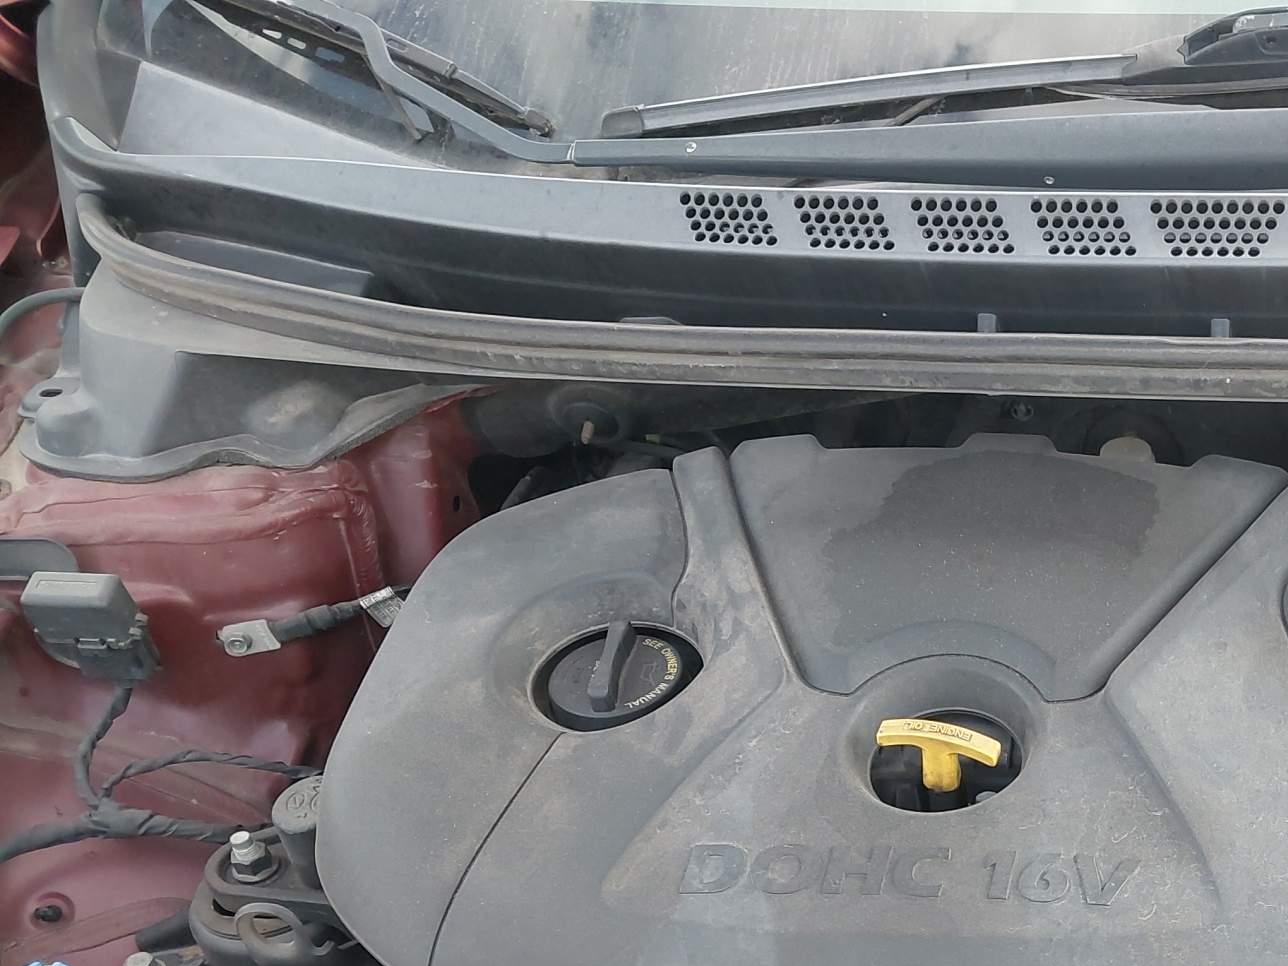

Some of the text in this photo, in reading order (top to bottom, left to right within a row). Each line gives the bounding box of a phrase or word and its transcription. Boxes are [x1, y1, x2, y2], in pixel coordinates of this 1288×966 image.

[623, 637, 680, 709] SEE OWNER'S MANUAL
[902, 720, 974, 742] ENGINE OIL
[679, 841, 1141, 907] DOHC 16V
